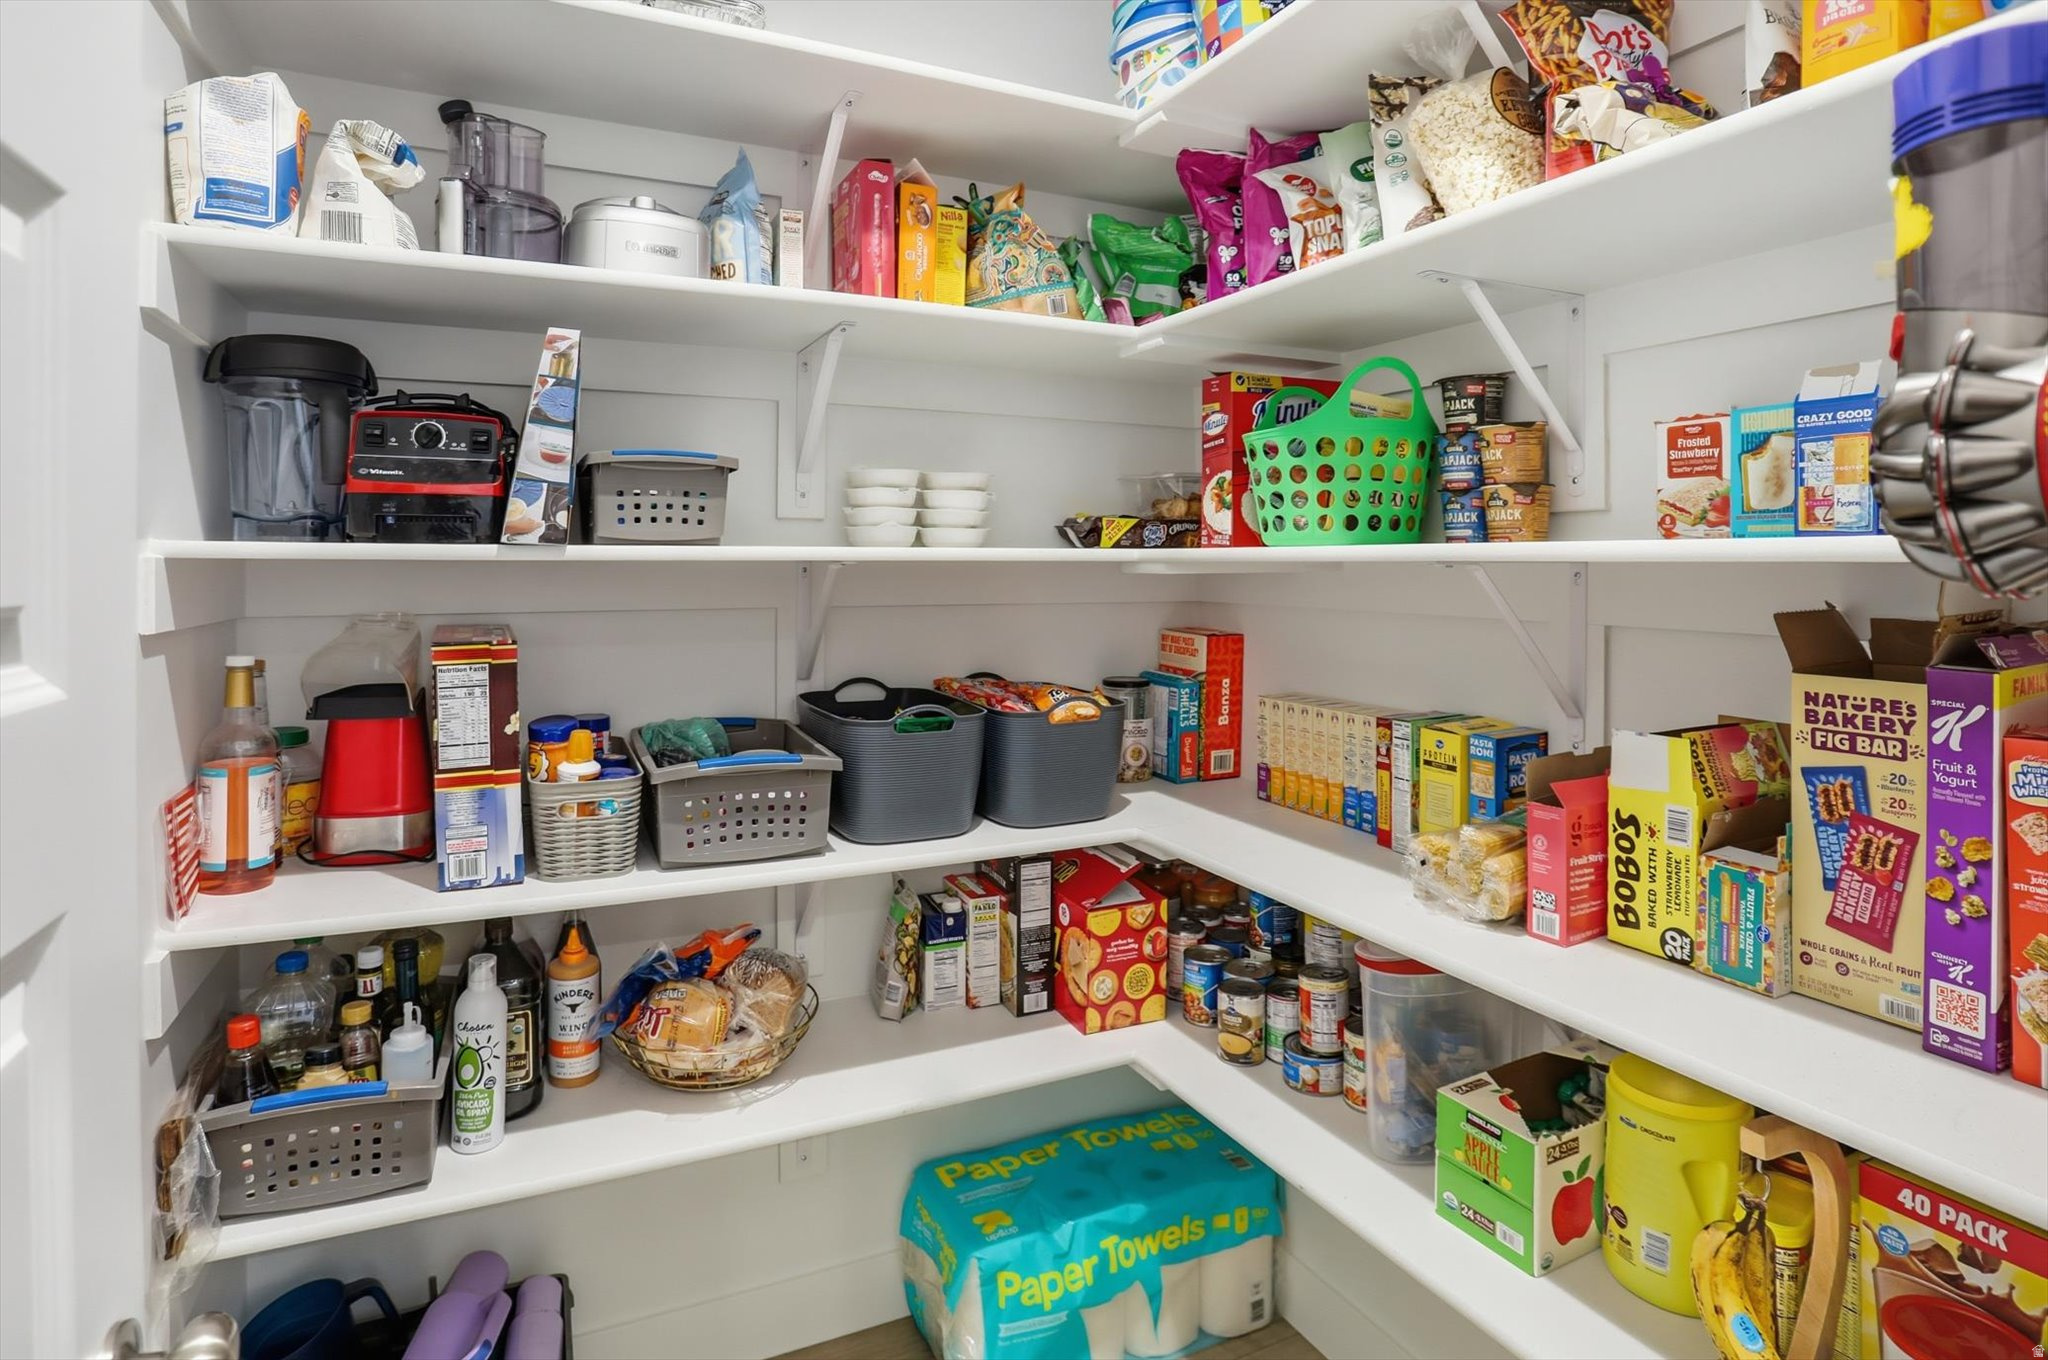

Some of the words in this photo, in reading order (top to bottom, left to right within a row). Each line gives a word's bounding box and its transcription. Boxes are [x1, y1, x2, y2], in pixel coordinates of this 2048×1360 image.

[1822, 4, 1865, 26] packs
[1585, 20, 1652, 50] Dot's
[941, 210, 963, 222] Nilla
[1280, 256, 1292, 264] 50
[1226, 273, 1240, 282] 50
[1445, 398, 1475, 410] PJACK
[1797, 412, 1833, 424] CRAZY
[1837, 408, 1872, 420] GOOD
[1677, 435, 1711, 448] Frosted
[1669, 447, 1720, 460] Strawberry
[369, 467, 404, 475] Vitamix
[1169, 522, 1199, 535] CHUNKY
[1180, 688, 1189, 727] SHELLS
[1218, 678, 1230, 726] Banza
[1930, 699, 1966, 709] SPECIAL
[1189, 701, 1199, 726] TACO
[1804, 708, 1917, 736] BAKERY
[1931, 704, 1987, 752] K
[1470, 737, 1493, 749] PASTA
[1815, 730, 1850, 751] FIG
[1856, 735, 1902, 758] BAR
[1423, 749, 1457, 765] PROTEIN
[1470, 746, 1494, 759] RONI
[1509, 752, 1538, 766] PASTA
[1933, 759, 1963, 773] Fruit
[1966, 764, 1977, 776] &
[2022, 764, 2048, 775] Froste
[1510, 773, 1526, 788] RO
[1889, 772, 1908, 787] 20
[1932, 771, 1977, 789] Yogurt
[2013, 785, 2048, 798] Whea
[1889, 797, 1908, 811] 20
[1612, 808, 1641, 931] BOBO'S
[1647, 847, 1657, 884] WITH
[1665, 849, 1674, 916] STRAWBERRY
[1674, 858, 1682, 912] LEMONADE
[1647, 888, 1657, 929] BAKED
[1746, 887, 1755, 921] FRUIT
[1665, 930, 1683, 961] 20
[1681, 935, 1691, 962] PACK
[1745, 931, 1754, 969] CREAM
[1799, 938, 1827, 953] WHOLE
[1829, 947, 1859, 962] GRAINS
[1869, 956, 1894, 972] Real
[1896, 965, 1922, 979] FRUIT
[457, 1021, 494, 1033] Chosen
[456, 1099, 490, 1109] AVOCADO
[466, 1105, 492, 1117] SPRAY
[1640, 1125, 1676, 1143] CHOCOLATE
[935, 1140, 1060, 1188] Paper
[1063, 1111, 1201, 1152] Towels
[1465, 1132, 1500, 1161] APPLE
[1547, 1147, 1560, 1163] 24
[1464, 1148, 1500, 1184] SAUCE
[1460, 1203, 1475, 1220] 24
[1897, 1188, 1931, 1217] 40
[1939, 1203, 2009, 1253] PACK
[996, 1253, 1098, 1312] Paper
[1100, 1214, 1206, 1275] Towels
